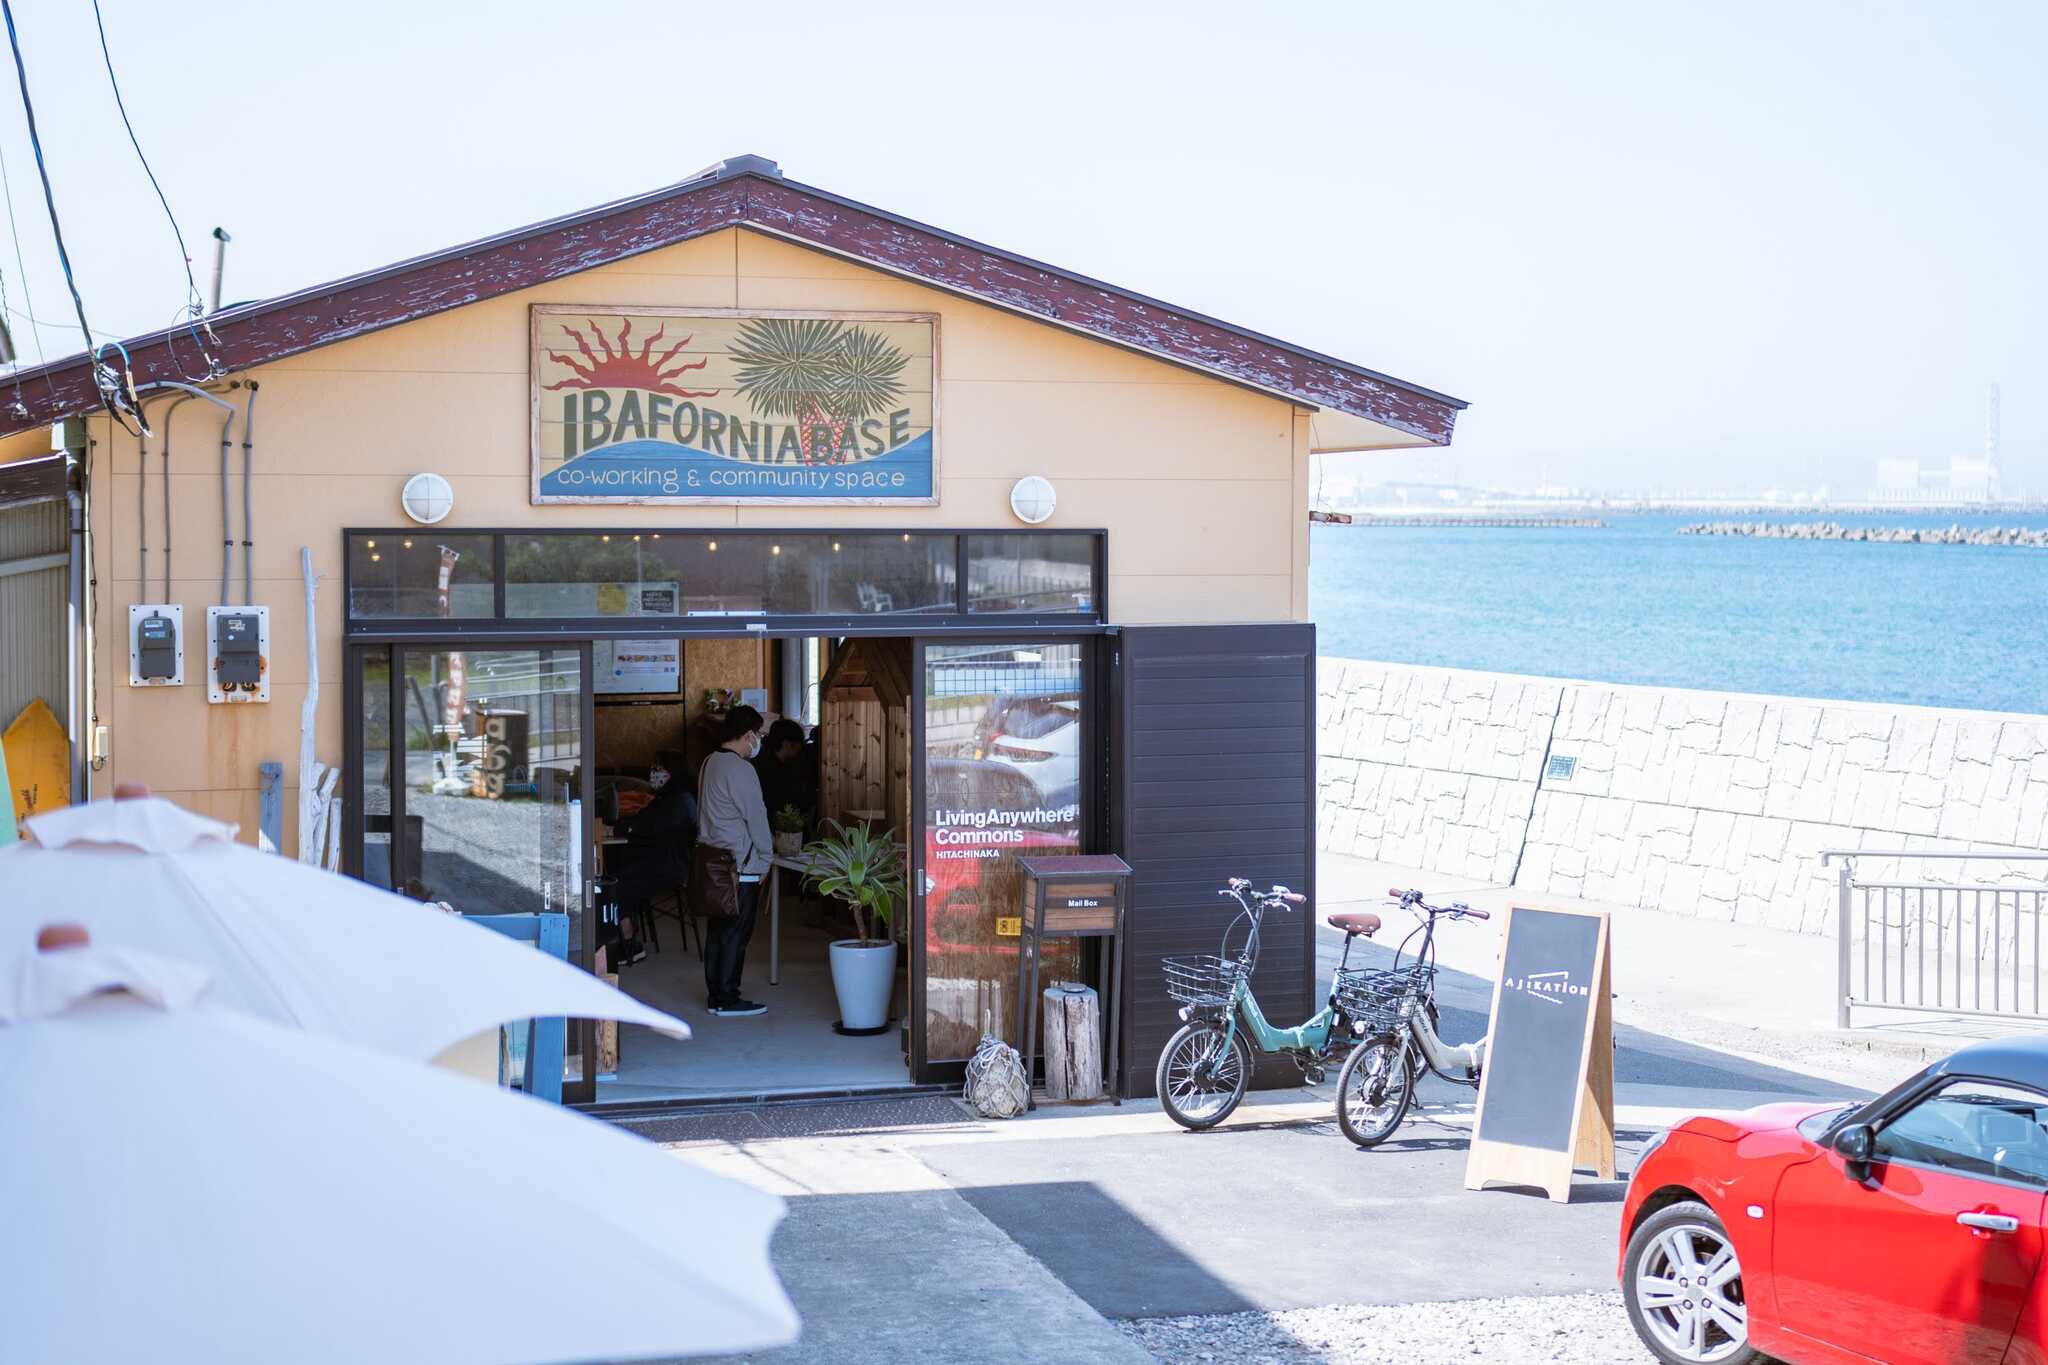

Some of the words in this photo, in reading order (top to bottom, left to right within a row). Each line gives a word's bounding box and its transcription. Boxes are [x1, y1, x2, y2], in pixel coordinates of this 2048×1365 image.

[563, 389, 802, 465] IBAFORNIA
[811, 407, 912, 465] BASE
[557, 467, 678, 494] co-working
[687, 468, 701, 488] &
[709, 468, 829, 489] community
[834, 470, 906, 488] space
[935, 807, 1074, 828] LivingAnywhere
[935, 828, 1024, 845] Commons
[936, 849, 1000, 859] HITACHINAKA
[1068, 899, 1083, 907] Mail
[1084, 899, 1098, 907] Box
